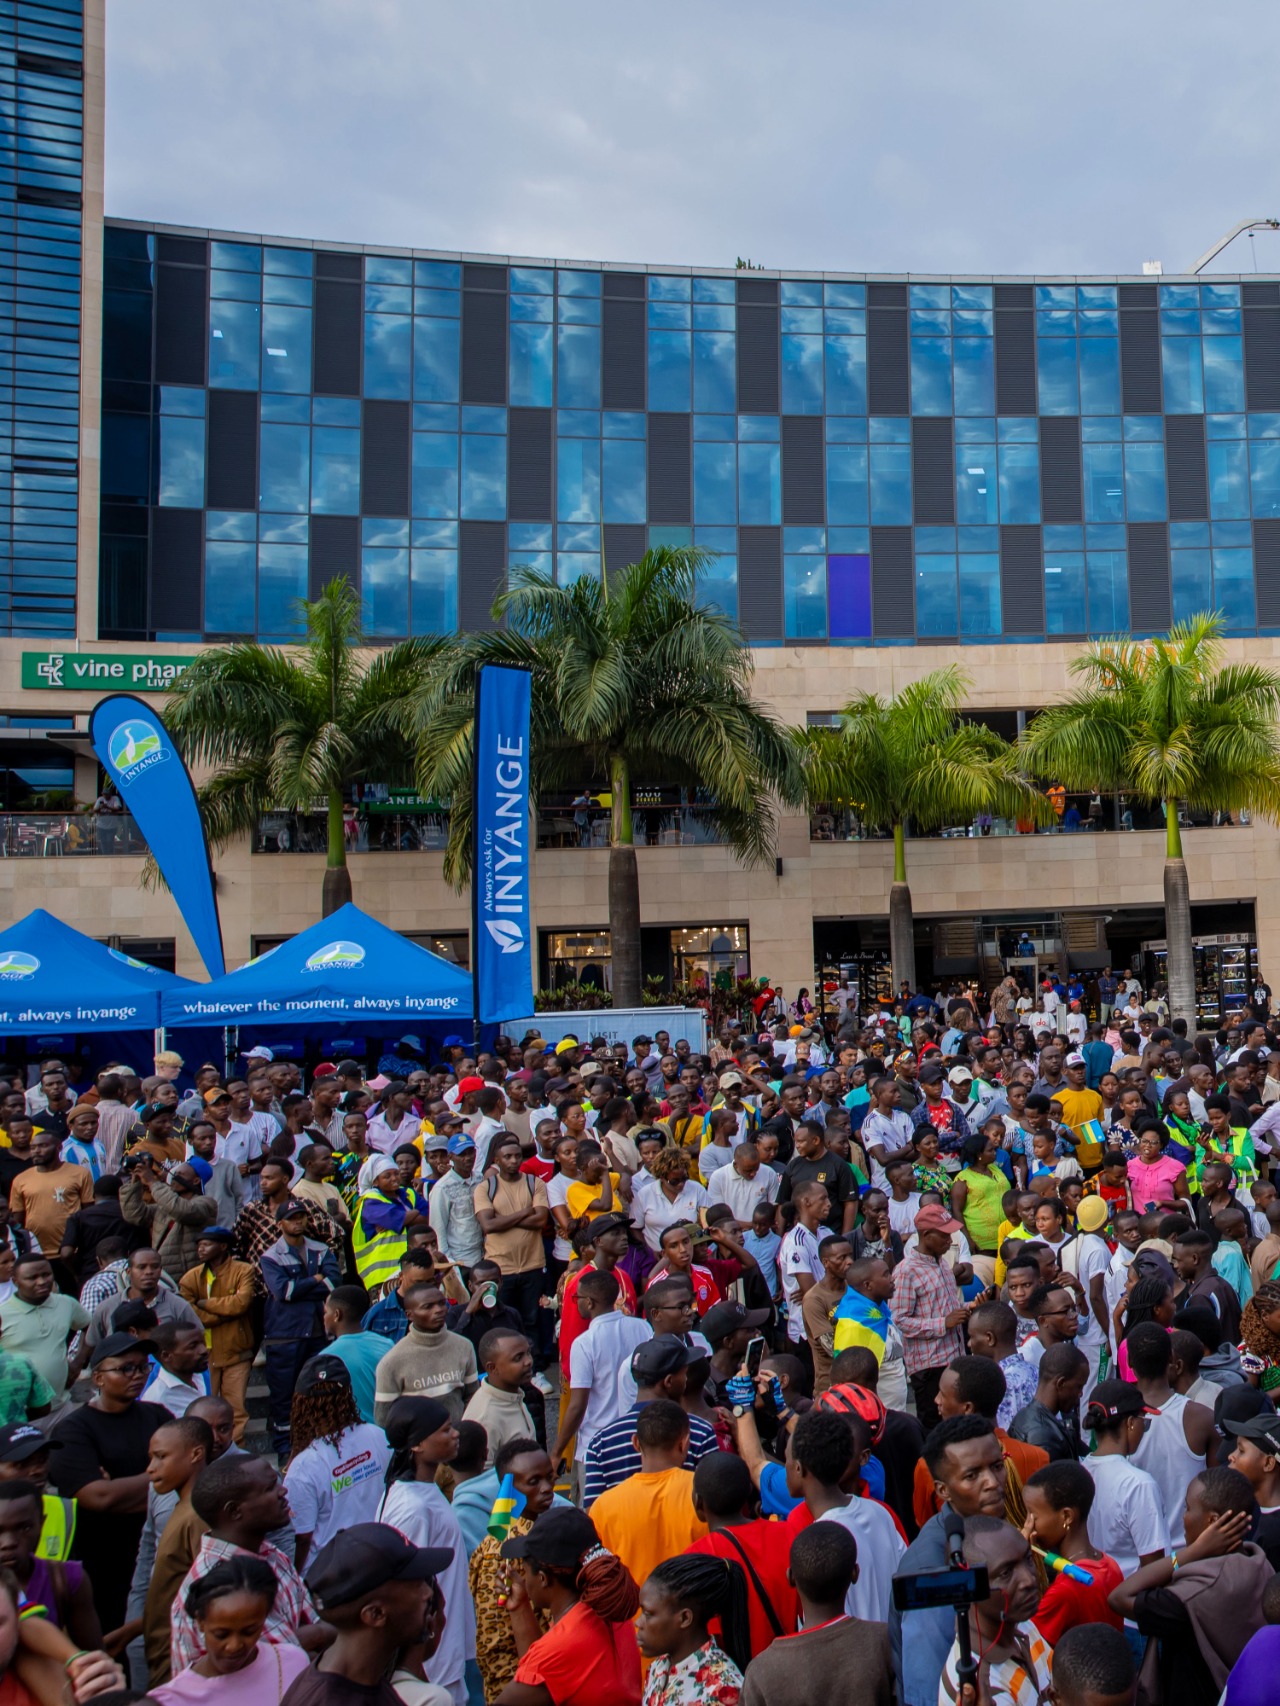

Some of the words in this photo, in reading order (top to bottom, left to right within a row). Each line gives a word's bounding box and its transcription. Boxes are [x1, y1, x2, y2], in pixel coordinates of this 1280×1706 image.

[73, 659, 125, 677] vine
[133, 660, 187, 682] phar
[124, 751, 164, 781] INYANGE
[494, 734, 523, 913] INYANGE
[484, 828, 493, 846] for
[484, 849, 493, 869] Ask
[484, 869, 494, 912] Always
[310, 960, 354, 971] INYANGE
[184, 1001, 253, 1014] whatever
[257, 999, 281, 1012] the
[285, 998, 349, 1011] moment,
[353, 996, 401, 1011] always
[405, 995, 459, 1010] inyange
[18, 1009, 72, 1024] always
[77, 1006, 137, 1022] inyange
[331, 1475, 353, 1494] We
